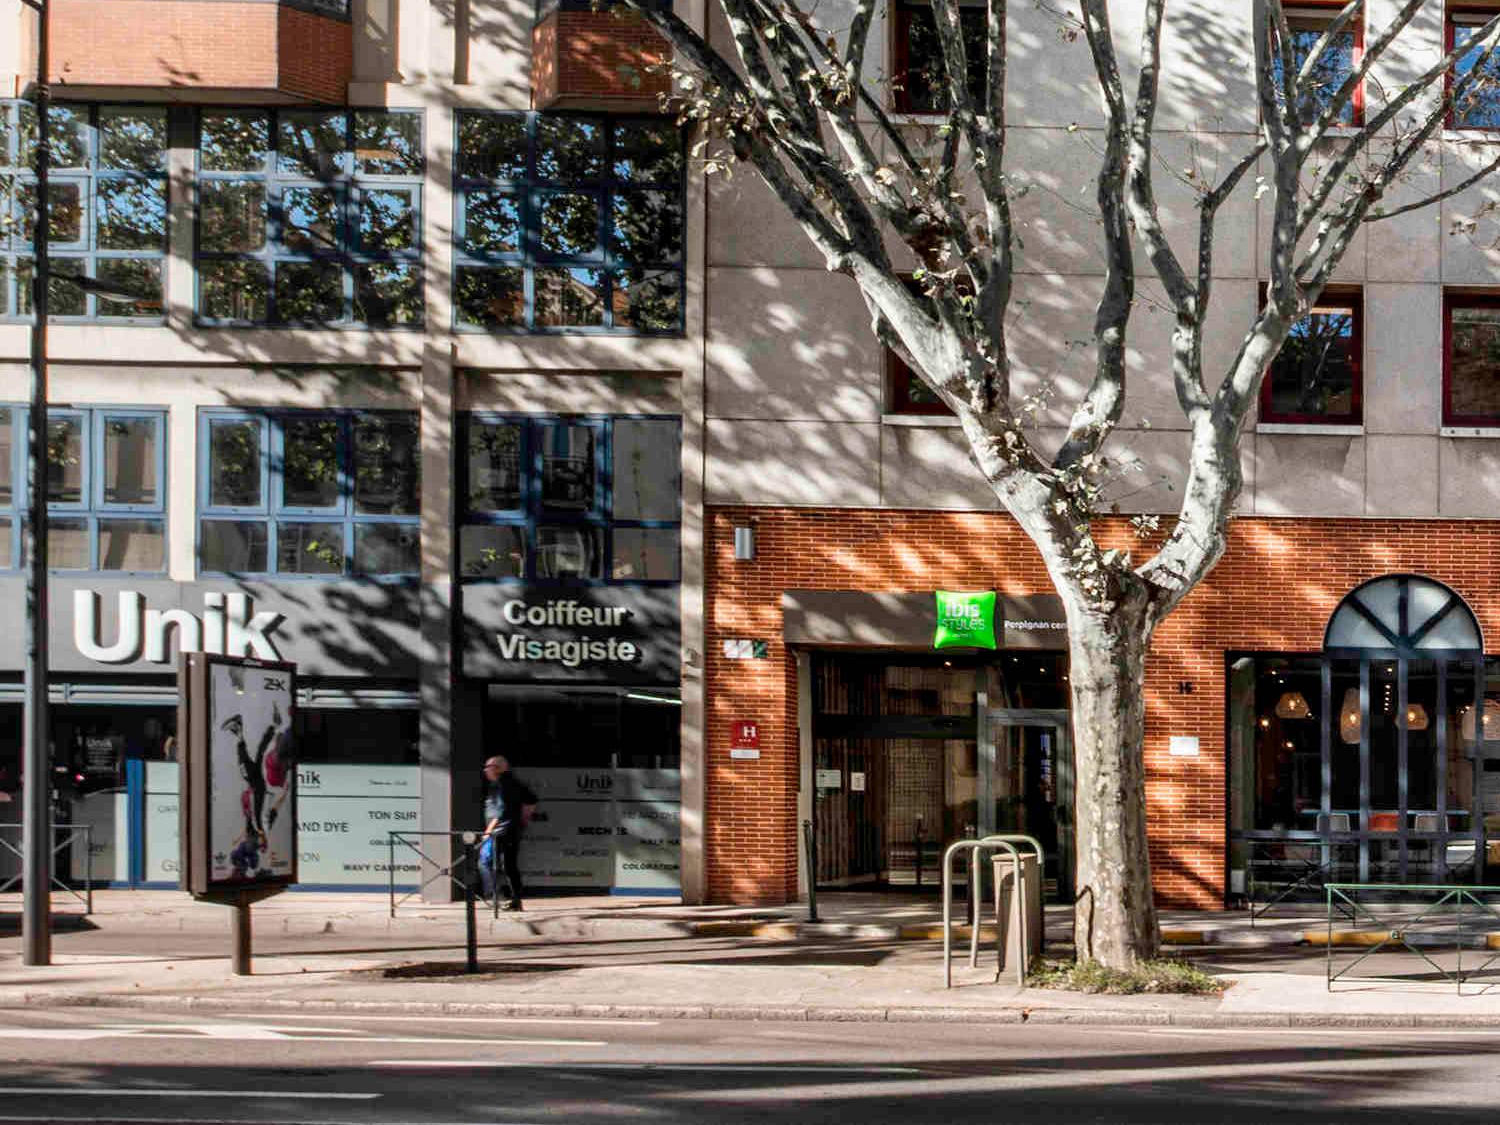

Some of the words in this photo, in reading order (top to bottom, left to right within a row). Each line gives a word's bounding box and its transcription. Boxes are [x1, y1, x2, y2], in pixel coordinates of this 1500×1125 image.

[503, 600, 627, 626] Coiffeur
[945, 600, 981, 618] ibis
[73, 589, 284, 662] Unik
[1004, 620, 1049, 631] Perpignan
[496, 633, 636, 667] Visagiste
[743, 726, 756, 738] H
[297, 771, 321, 785] nik
[368, 810, 391, 820] TON
[393, 811, 417, 821] SUR
[323, 821, 350, 833] DYE
